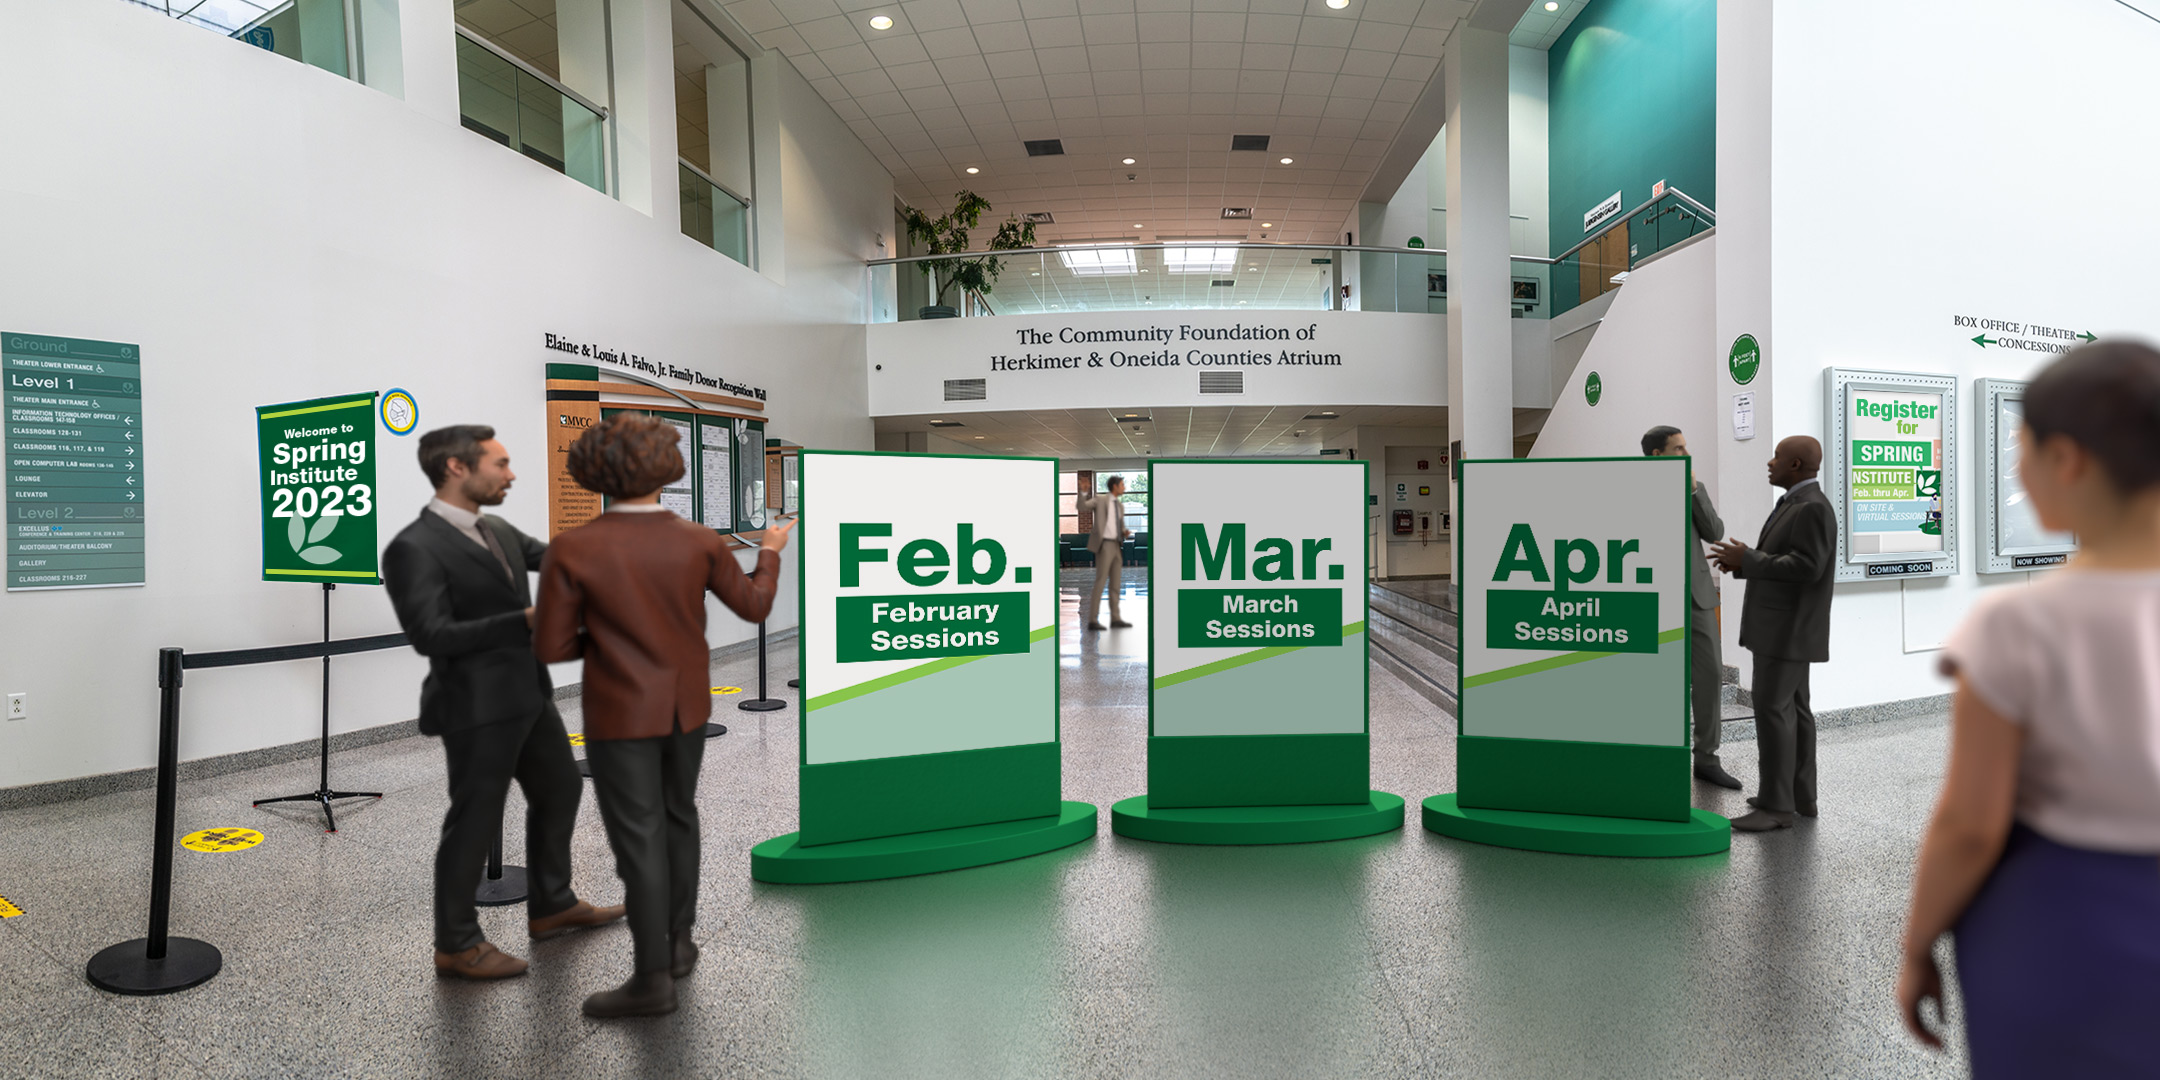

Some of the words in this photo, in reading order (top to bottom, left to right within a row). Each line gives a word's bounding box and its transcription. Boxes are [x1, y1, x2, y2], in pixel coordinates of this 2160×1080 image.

[1016, 328, 1053, 345] The
[1059, 326, 1174, 345] Community
[1179, 324, 1290, 341] Foundation
[1296, 324, 1317, 341] of
[1954, 315, 1977, 328] BOX
[1980, 318, 2020, 333] OFFICE
[2021, 324, 2028, 336] /
[2031, 325, 2076, 340] THEATER
[11, 337, 67, 352] Ground
[1998, 337, 2072, 354] CONCESSIONS
[12, 359, 39, 367] THEATER
[63, 363, 93, 371] ENTRANCE
[545, 333, 579, 354] Elaine
[581, 344, 591, 356] &
[593, 344, 618, 363] Louis
[620, 352, 629, 366] A.
[632, 354, 656, 375] Falvo,
[657, 362, 667, 377] Jr.
[669, 364, 694, 385] Family
[695, 371, 717, 388] Donor
[719, 378, 753, 397] Recognition
[754, 388, 767, 401] Wall
[990, 353, 1082, 371] Herkimer
[1087, 351, 1104, 368] &
[1110, 350, 1180, 368] Oneida
[1186, 349, 1272, 366] Counties
[1277, 350, 1342, 366] Atrium
[12, 374, 58, 389] Level
[66, 378, 74, 389] 1
[55, 411, 91, 419] TECHNOLOGY
[1856, 398, 1938, 421] Register
[568, 416, 592, 427] MVCC
[1896, 420, 1918, 434] for
[284, 426, 337, 439] Welcome
[341, 424, 354, 433] to
[273, 438, 366, 469] Spring
[1861, 445, 1923, 462] SPRING
[271, 466, 358, 485] Institute
[272, 484, 372, 517] 2023
[1853, 488, 1871, 497] Feb.
[1873, 488, 1891, 497] thru
[1893, 489, 1909, 498] Apr.
[18, 507, 58, 519] Level
[64, 507, 74, 519] 2
[1857, 503, 1869, 511] ON
[1869, 503, 1887, 511] SITE
[1888, 503, 1894, 511] &
[1857, 512, 1888, 521] VIRTUAL
[1891, 512, 1927, 521] SESSIONS
[839, 523, 1032, 587] Feb.
[1181, 523, 1344, 581] Mar.
[1491, 523, 1653, 591] Apr.
[2017, 558, 2032, 566] NOW
[2034, 556, 2065, 565] SHOWING
[1870, 565, 1903, 574] COMING
[1907, 564, 1932, 572] SOON
[872, 602, 999, 623] February
[1223, 595, 1298, 613] March
[1541, 597, 1600, 620] April
[1206, 619, 1315, 638] Sessions
[1515, 621, 1628, 643] Sessions
[871, 627, 1000, 651] Sessions
